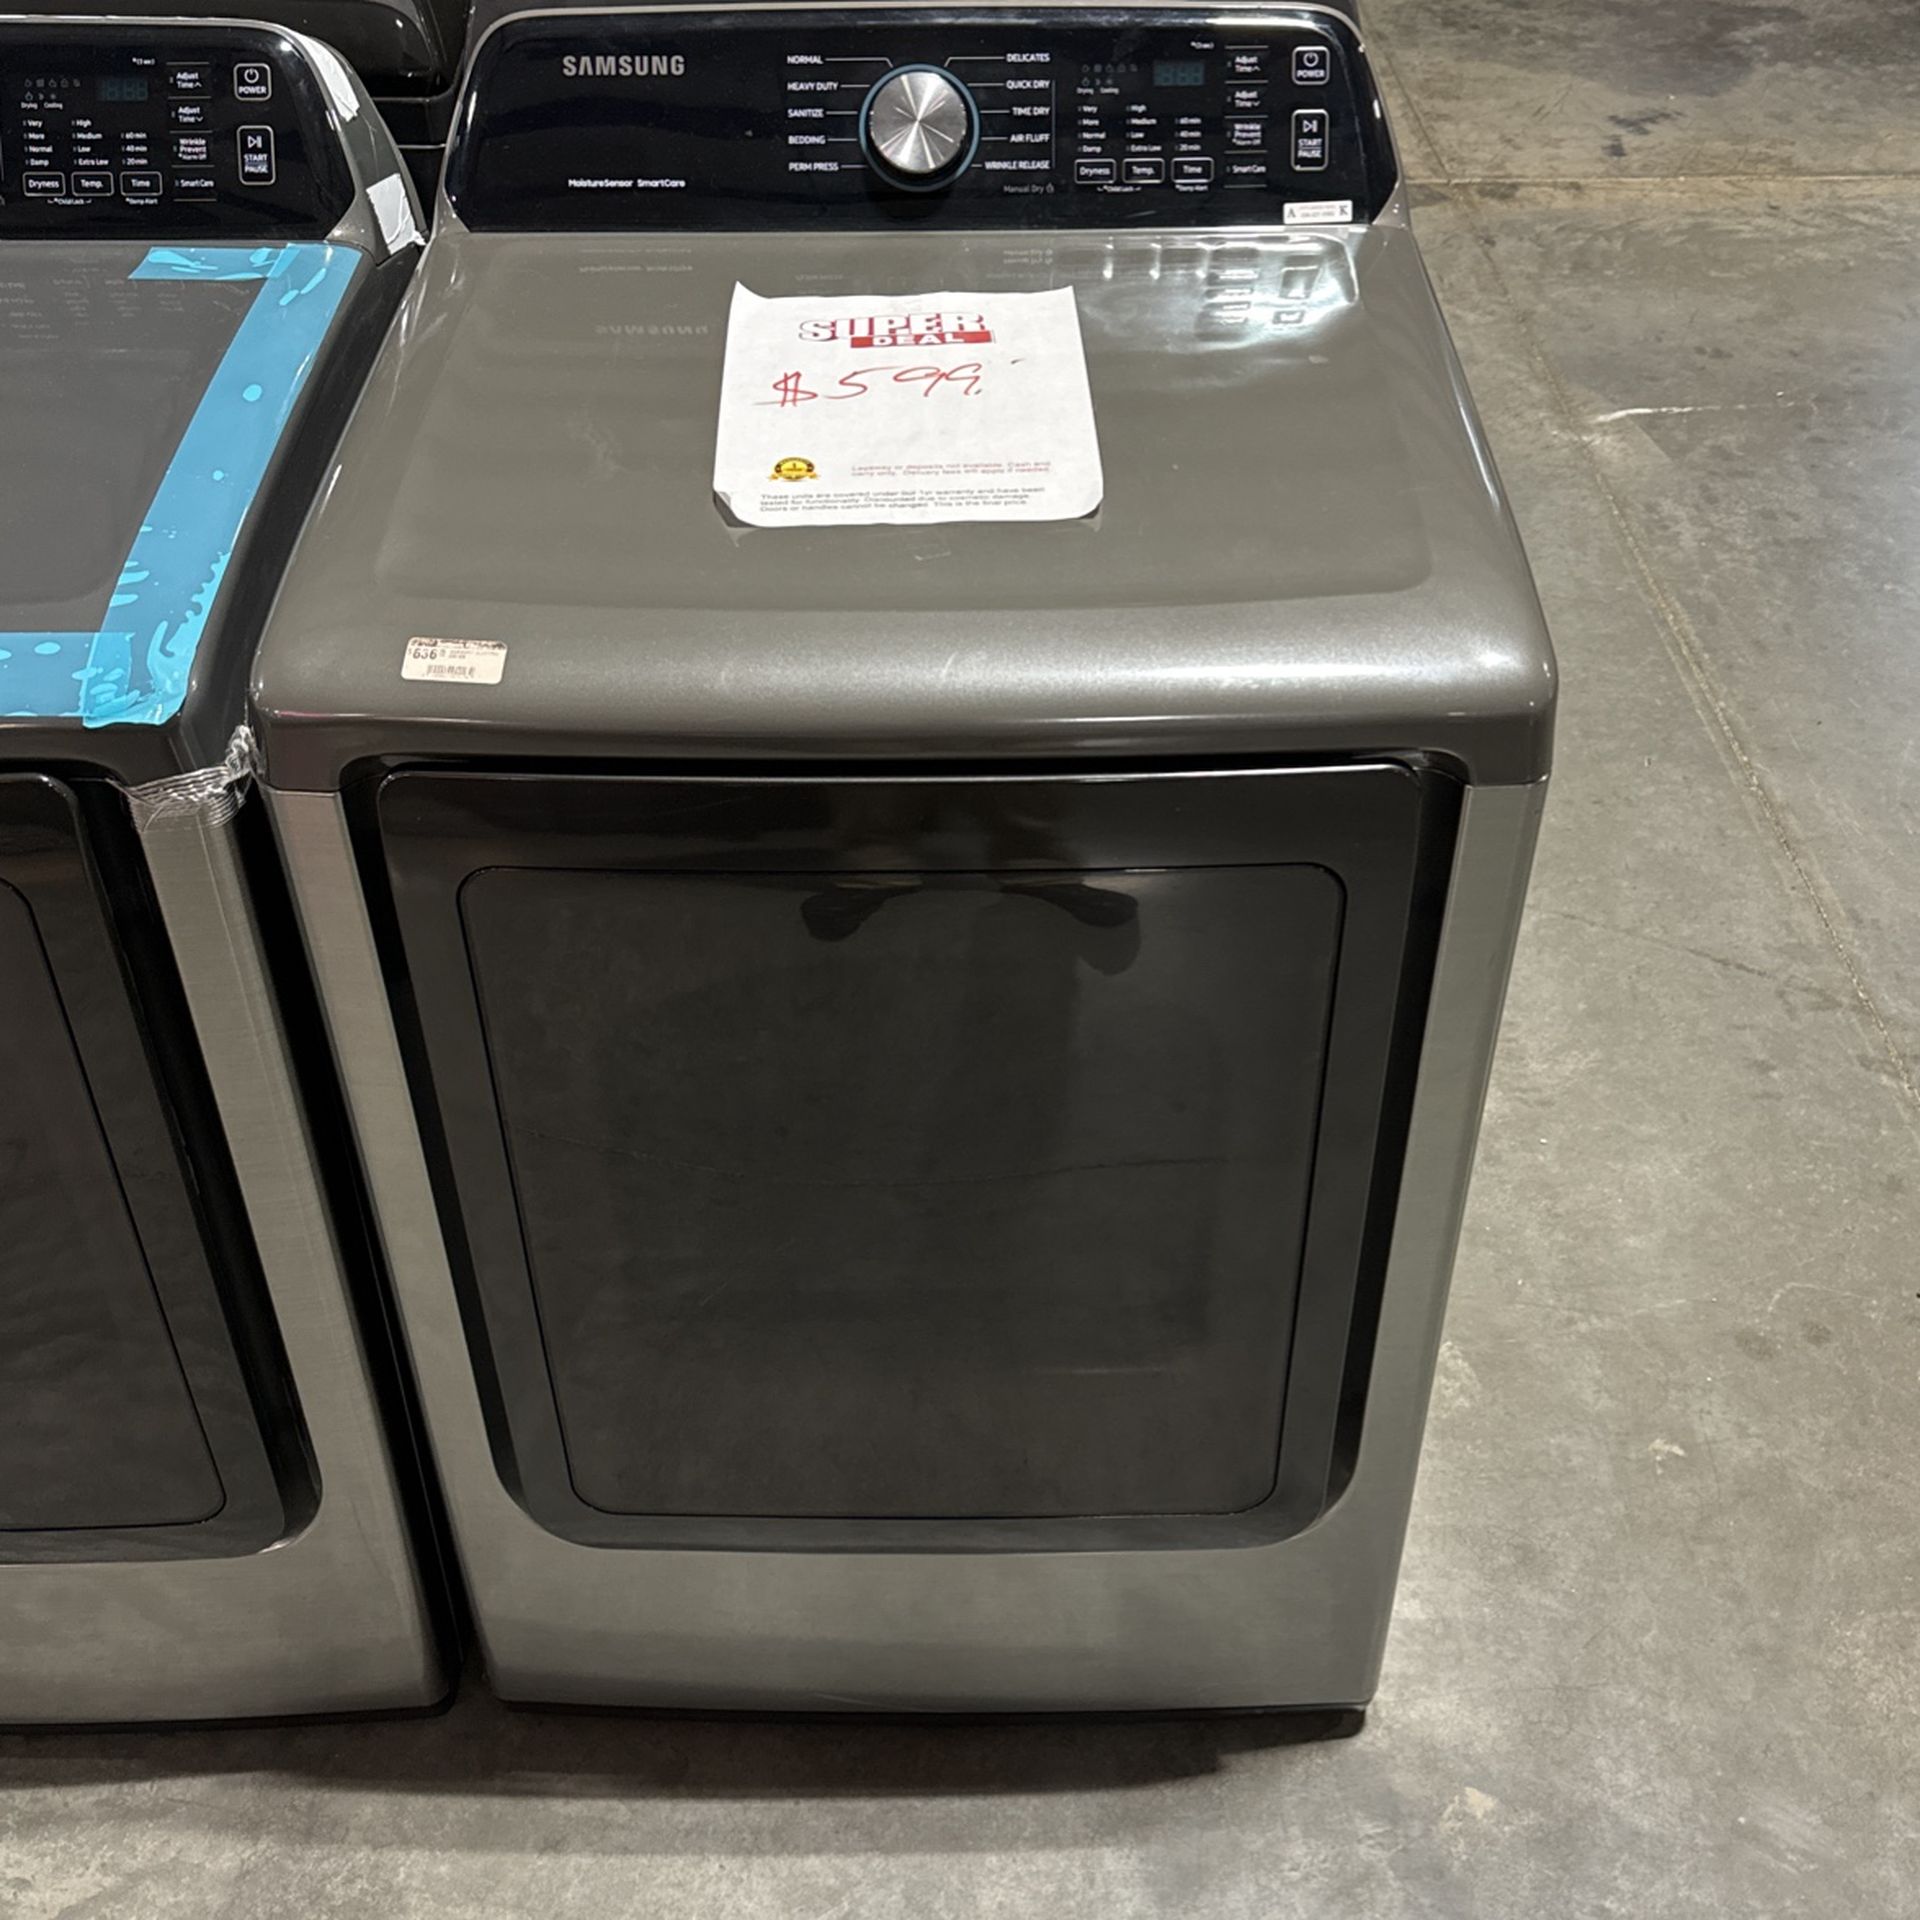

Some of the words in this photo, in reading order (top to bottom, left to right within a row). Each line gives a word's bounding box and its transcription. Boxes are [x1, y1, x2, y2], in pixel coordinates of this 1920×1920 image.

[787, 55, 823, 65] NORMAL
[1006, 53, 1050, 62] DELICATES
[562, 55, 685, 76] SAMSUNG
[176, 72, 199, 81] Adjust
[1296, 69, 1325, 78] POWER
[177, 81, 194, 89] Time
[787, 82, 814, 91] HEAVY
[816, 82, 838, 91] DUTY
[1006, 80, 1029, 89] QUICK
[1031, 80, 1050, 89] DRY
[238, 86, 267, 95] POWER
[178, 106, 200, 115] Adjust
[788, 109, 824, 118] SANITIZE
[1012, 107, 1030, 116] TIME
[1033, 107, 1050, 116] DRY
[76, 119, 92, 128] High
[179, 115, 195, 123] Time
[28, 120, 43, 128] Very
[788, 135, 826, 145] BEDDING
[1010, 133, 1023, 143] AIR
[1024, 133, 1050, 143] FLUFF
[29, 145, 53, 153] Normal
[78, 145, 91, 153] Low
[244, 153, 268, 161] START
[30, 158, 49, 167] Damp
[78, 158, 95, 166] Extra
[96, 158, 109, 166] Low
[789, 162, 812, 171] PERM
[813, 162, 839, 171] PRESS
[985, 160, 1016, 170] WRINKLE
[1018, 160, 1050, 170] RELEASE
[244, 164, 268, 174] PAUSE
[1080, 167, 1111, 177] Dryness
[1183, 164, 1203, 174] Time
[28, 179, 60, 190] Dryness
[131, 178, 151, 188] Time
[568, 179, 634, 188] MoistureSensor
[636, 179, 686, 188] SmartCare
[1003, 184, 1028, 193] Manual
[1030, 184, 1045, 194] Dry
[799, 312, 986, 341] SUPER
[872, 333, 965, 347] DEAL
